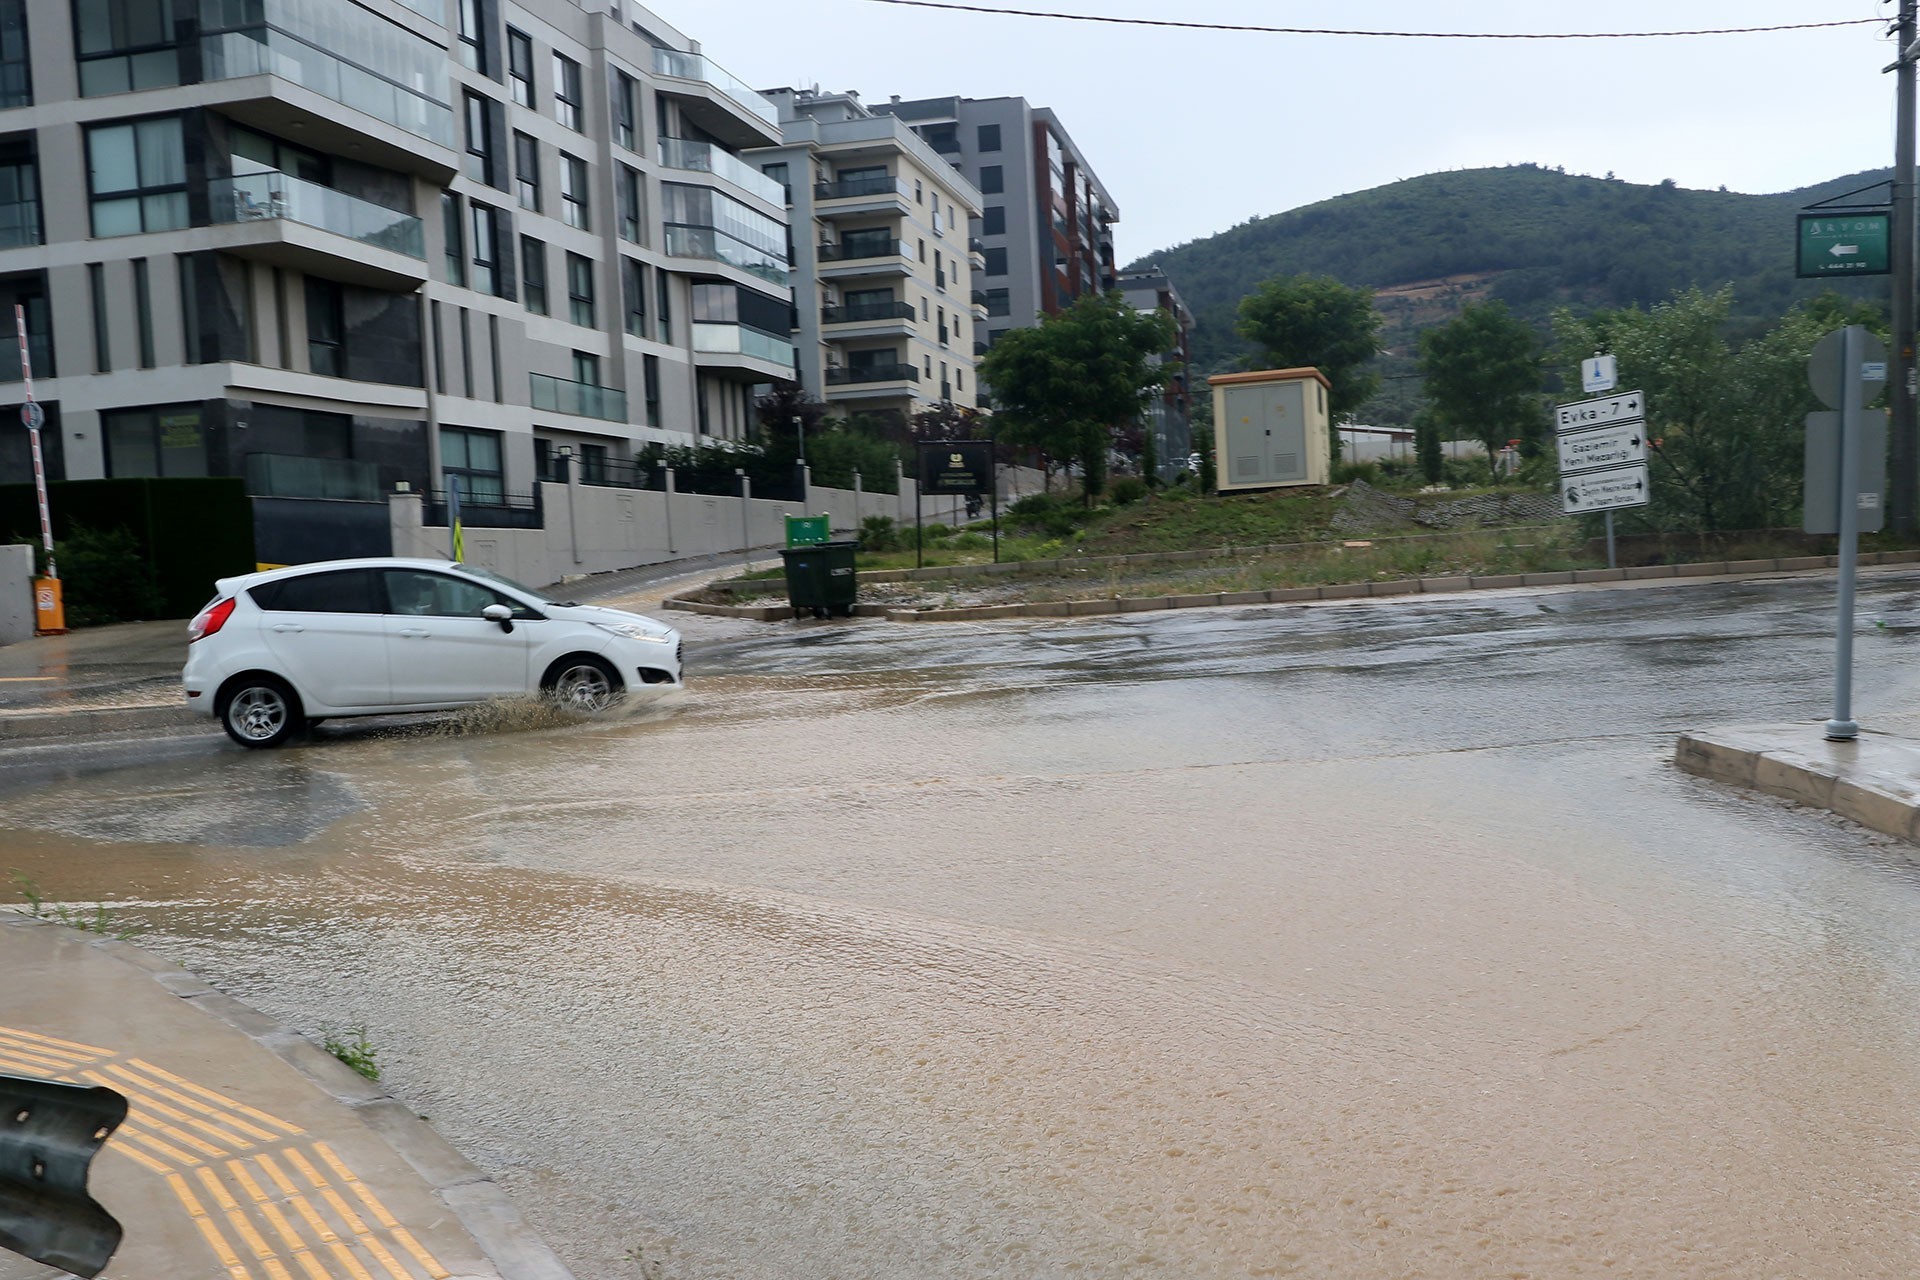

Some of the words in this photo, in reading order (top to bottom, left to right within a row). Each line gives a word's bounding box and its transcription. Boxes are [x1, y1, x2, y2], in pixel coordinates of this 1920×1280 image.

[1561, 408, 1597, 424] Evka
[1610, 402, 1619, 415] 7
[1571, 439, 1619, 453] Gaziemir
[1563, 456, 1584, 467] Yeni
